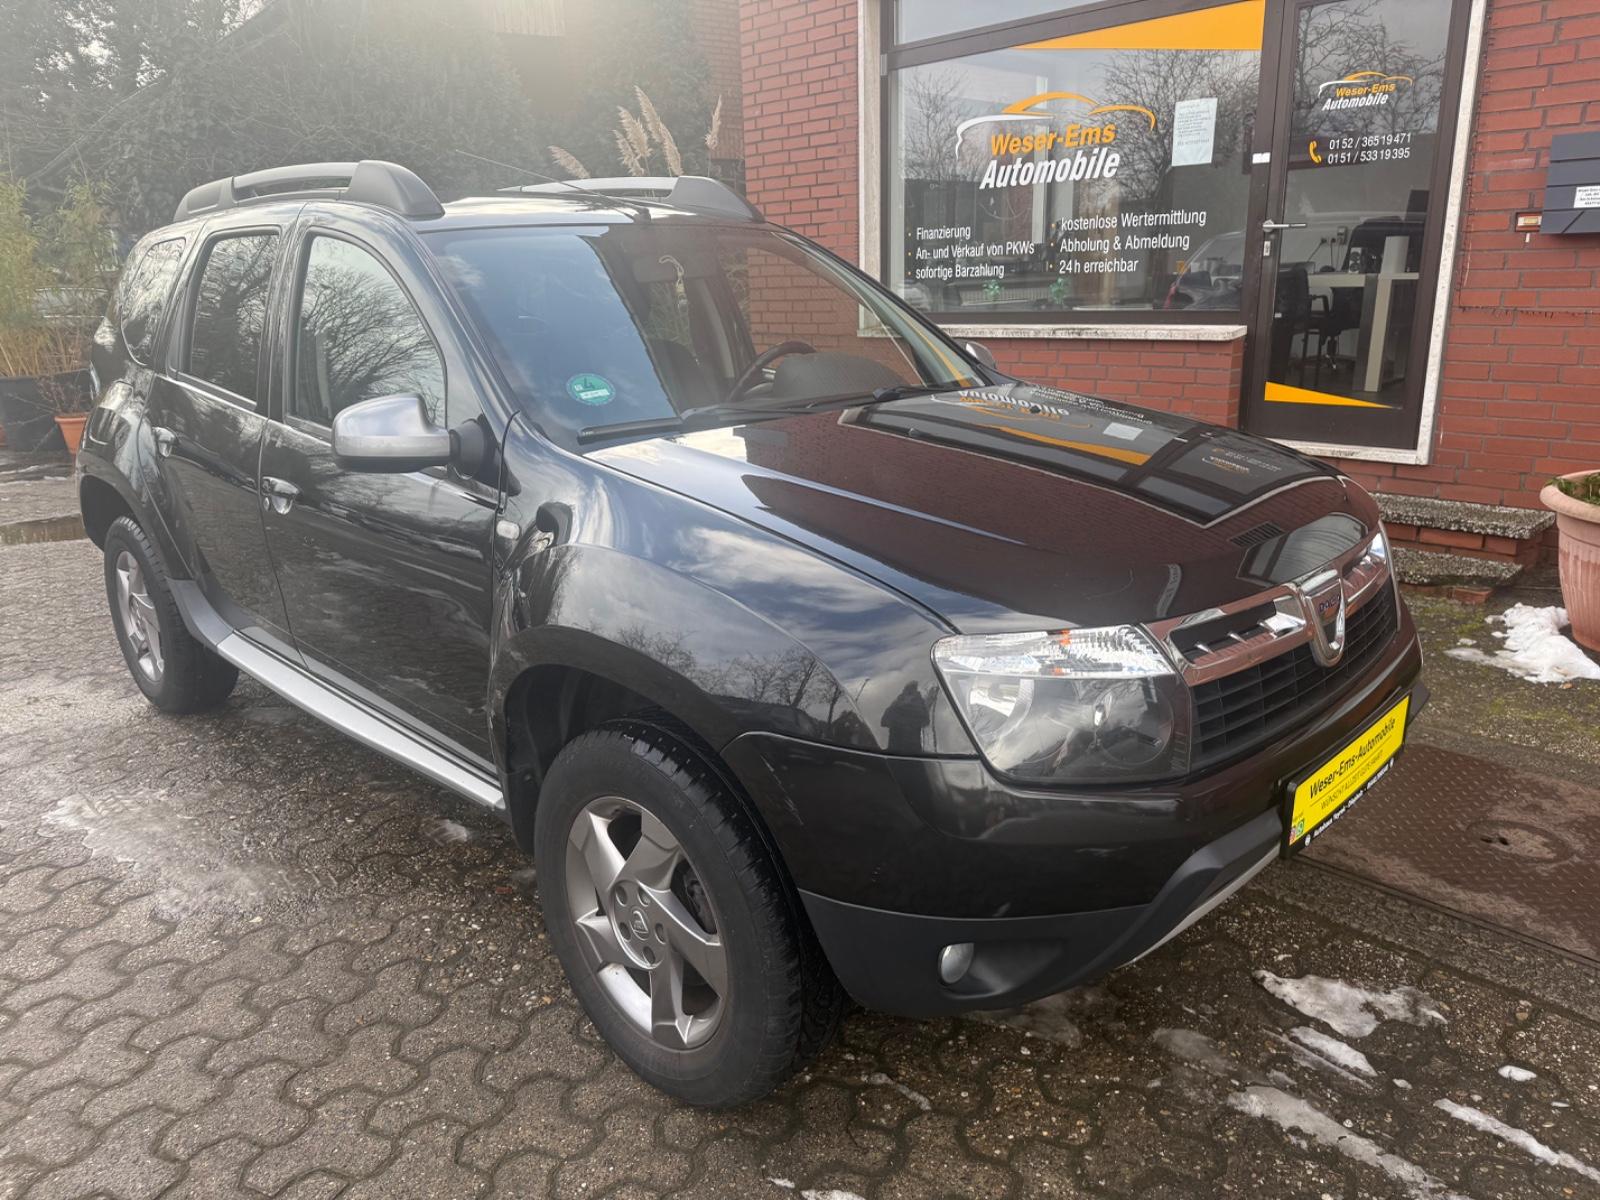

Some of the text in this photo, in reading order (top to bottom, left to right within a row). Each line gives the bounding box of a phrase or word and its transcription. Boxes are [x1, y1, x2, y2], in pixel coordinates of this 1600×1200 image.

[1336, 84, 1396, 98] Weser-Ems
[1322, 93, 1388, 111] Automobile
[991, 123, 1117, 156] Weser-Ems
[979, 147, 1120, 190] Automobile
[1061, 209, 1207, 231] kostenlose Wertermittlung
[916, 226, 971, 240] Finanzierung
[915, 240, 1035, 260] An- und Verkauf von PKWs
[1059, 233, 1190, 254] Abholung & Abmeldung
[915, 263, 1005, 280] sofortige Barzahlung
[1083, 258, 1140, 273] erreichbar
